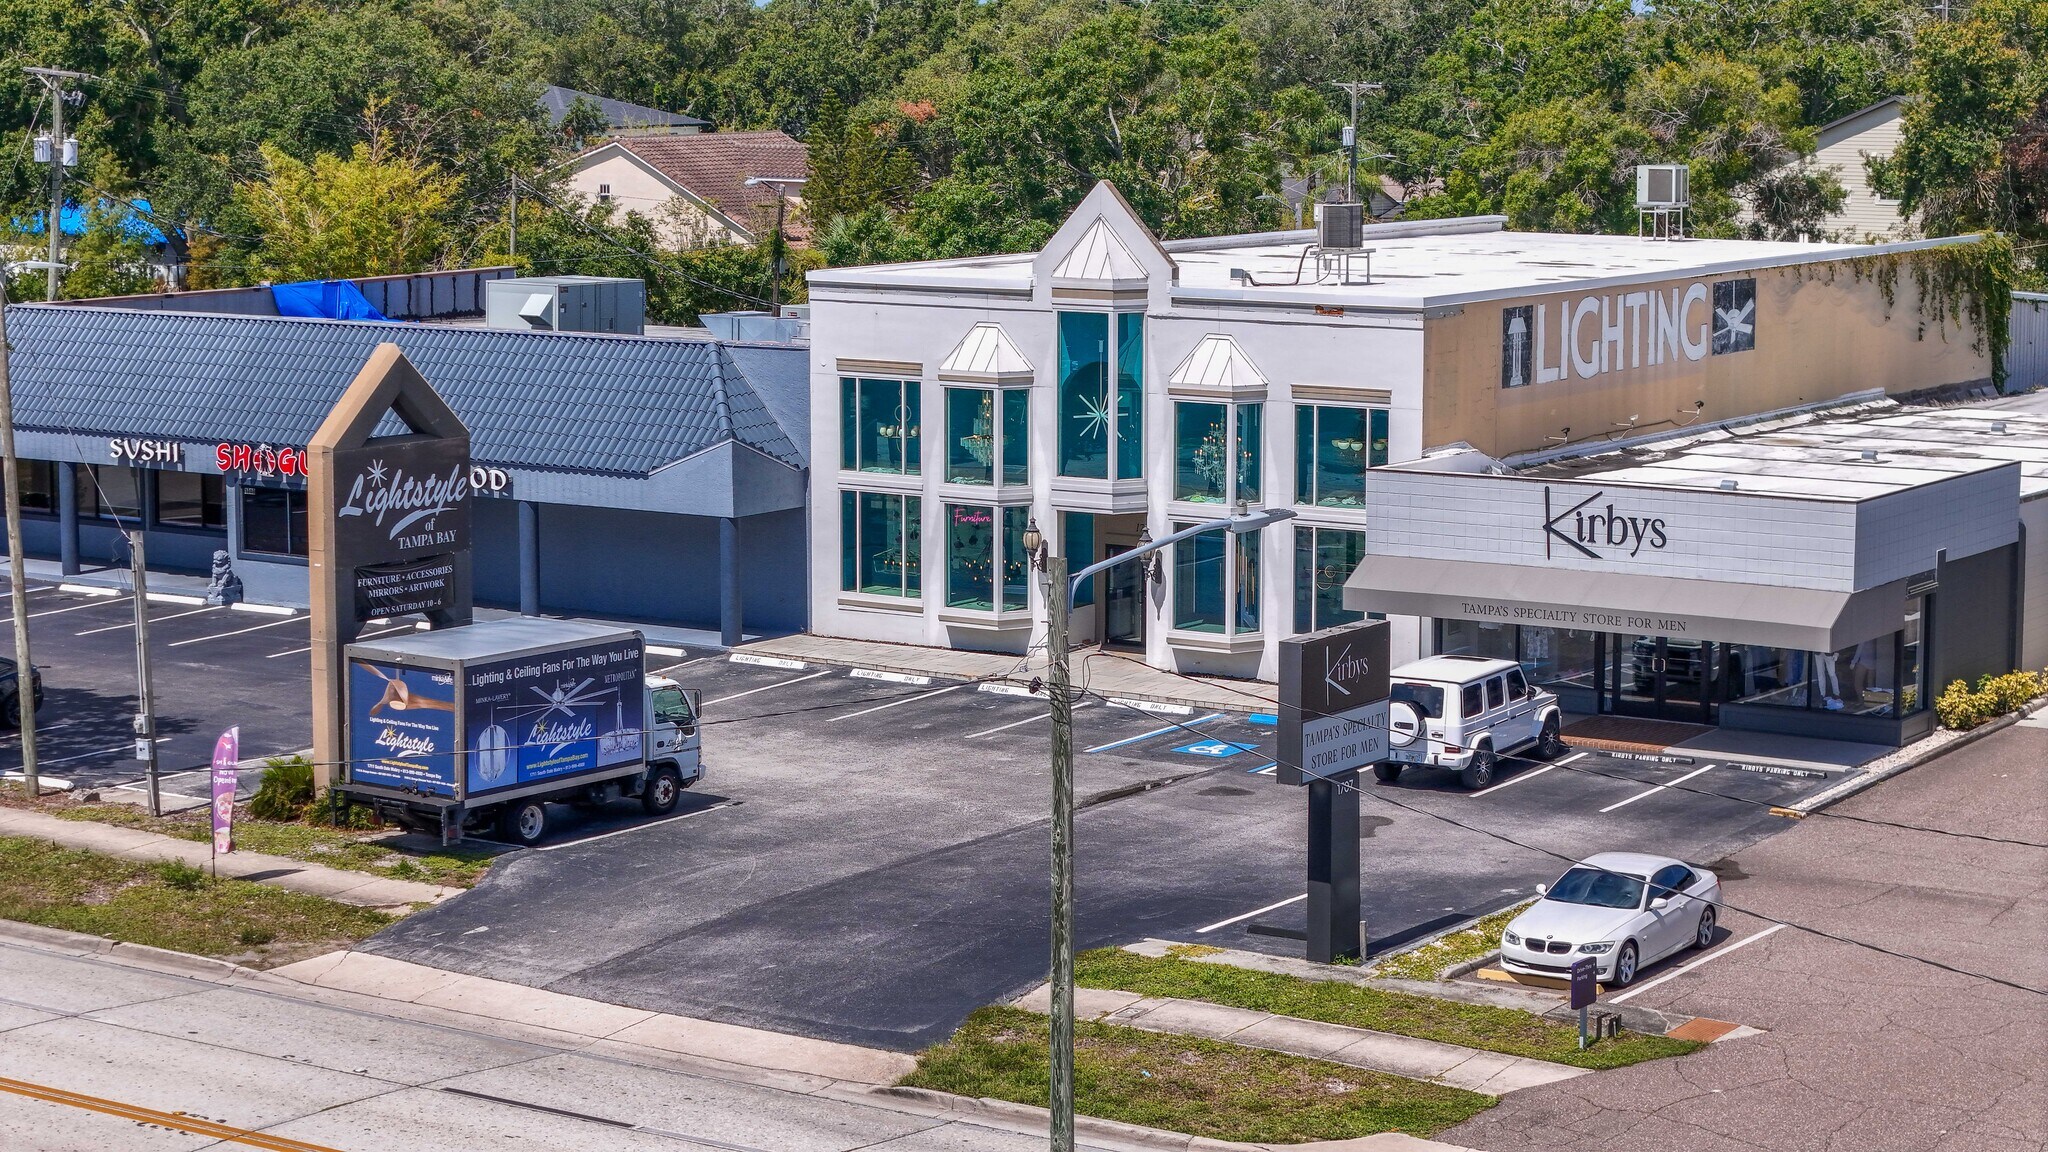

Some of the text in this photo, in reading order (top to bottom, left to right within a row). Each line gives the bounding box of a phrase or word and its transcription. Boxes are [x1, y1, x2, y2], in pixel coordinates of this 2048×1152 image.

[1536, 282, 1709, 384] LIGHTING
[216, 442, 308, 477] SHOGU
[470, 467, 507, 491] OD
[338, 462, 468, 527] Lightstyle
[425, 518, 435, 532] of
[954, 507, 991, 527] Furniture
[1543, 485, 1668, 561] Kirbys
[398, 529, 457, 550] TAMPA BAY
[357, 565, 453, 588] FURNITURE ACCESSORIES
[368, 579, 445, 599] MIRRORS ARTWORK
[371, 606, 390, 616] OPEN
[391, 600, 426, 614] SATURDAY
[1462, 602, 1687, 632] TAMPA'S SPECIALTY STORE FOR MEN
[472, 648, 639, 687] Lighting & Ceiling Fans For The Way You Live
[736, 655, 761, 663] LIGHTING
[857, 670, 884, 678] LIGHTING
[1325, 643, 1370, 706] Kirbys
[375, 728, 435, 753] Lightstyle
[524, 717, 592, 751] Lightstyle
[1304, 711, 1387, 748] TAMPA'S SPECIALTY
[1311, 736, 1379, 770] STORE FOR MEN
[1635, 754, 1659, 762] PARKING
[1766, 767, 1791, 775] PARKING
